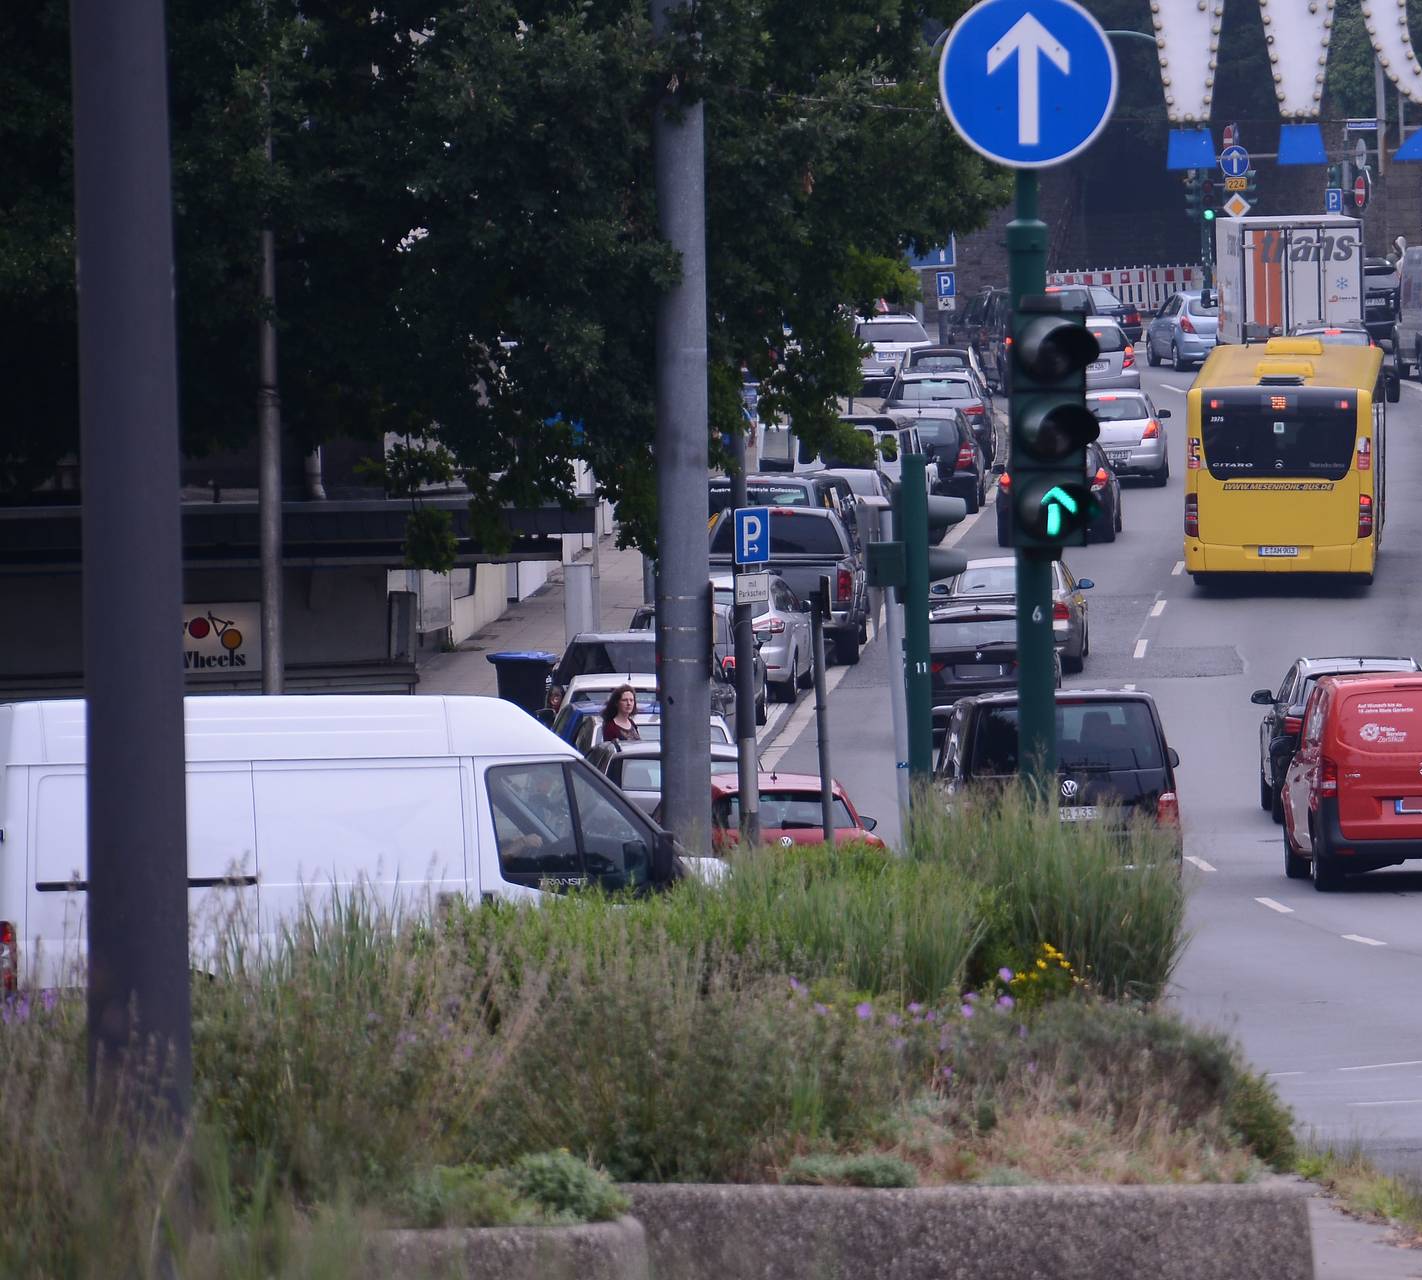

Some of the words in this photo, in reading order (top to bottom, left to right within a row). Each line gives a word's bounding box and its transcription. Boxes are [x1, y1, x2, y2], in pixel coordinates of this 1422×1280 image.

[1228, 180, 1245, 189] 224
[1261, 234, 1355, 263] trans
[769, 486, 801, 494] Collection
[743, 515, 761, 557] P
[1032, 606, 1043, 622] 6
[915, 662, 927, 674] 11
[538, 877, 588, 887] TRANSIT
